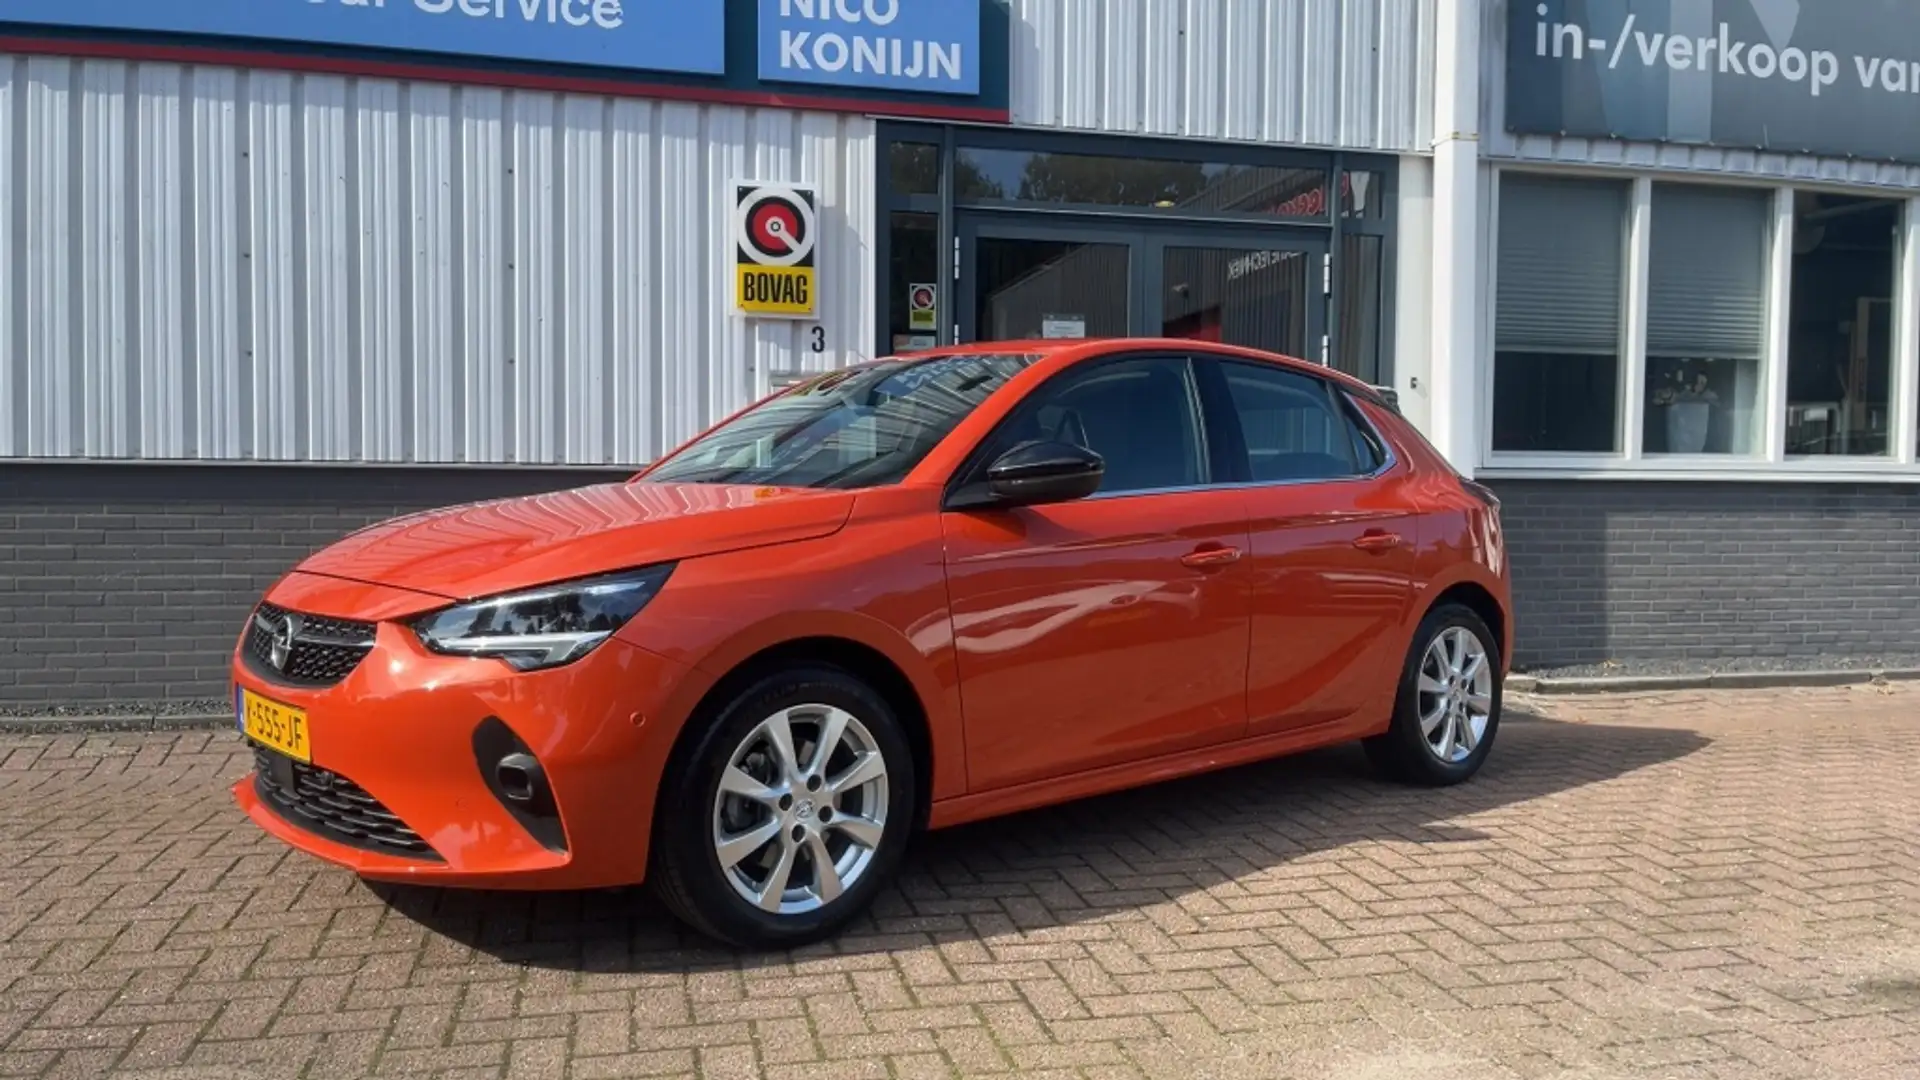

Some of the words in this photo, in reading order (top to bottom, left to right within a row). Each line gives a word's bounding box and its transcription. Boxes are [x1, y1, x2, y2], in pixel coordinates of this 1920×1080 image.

[780, 30, 961, 80] KONIJN
[1536, 3, 1839, 96] in-/verkoop
[743, 271, 808, 305] BOVAG
[811, 325, 826, 353] 3
